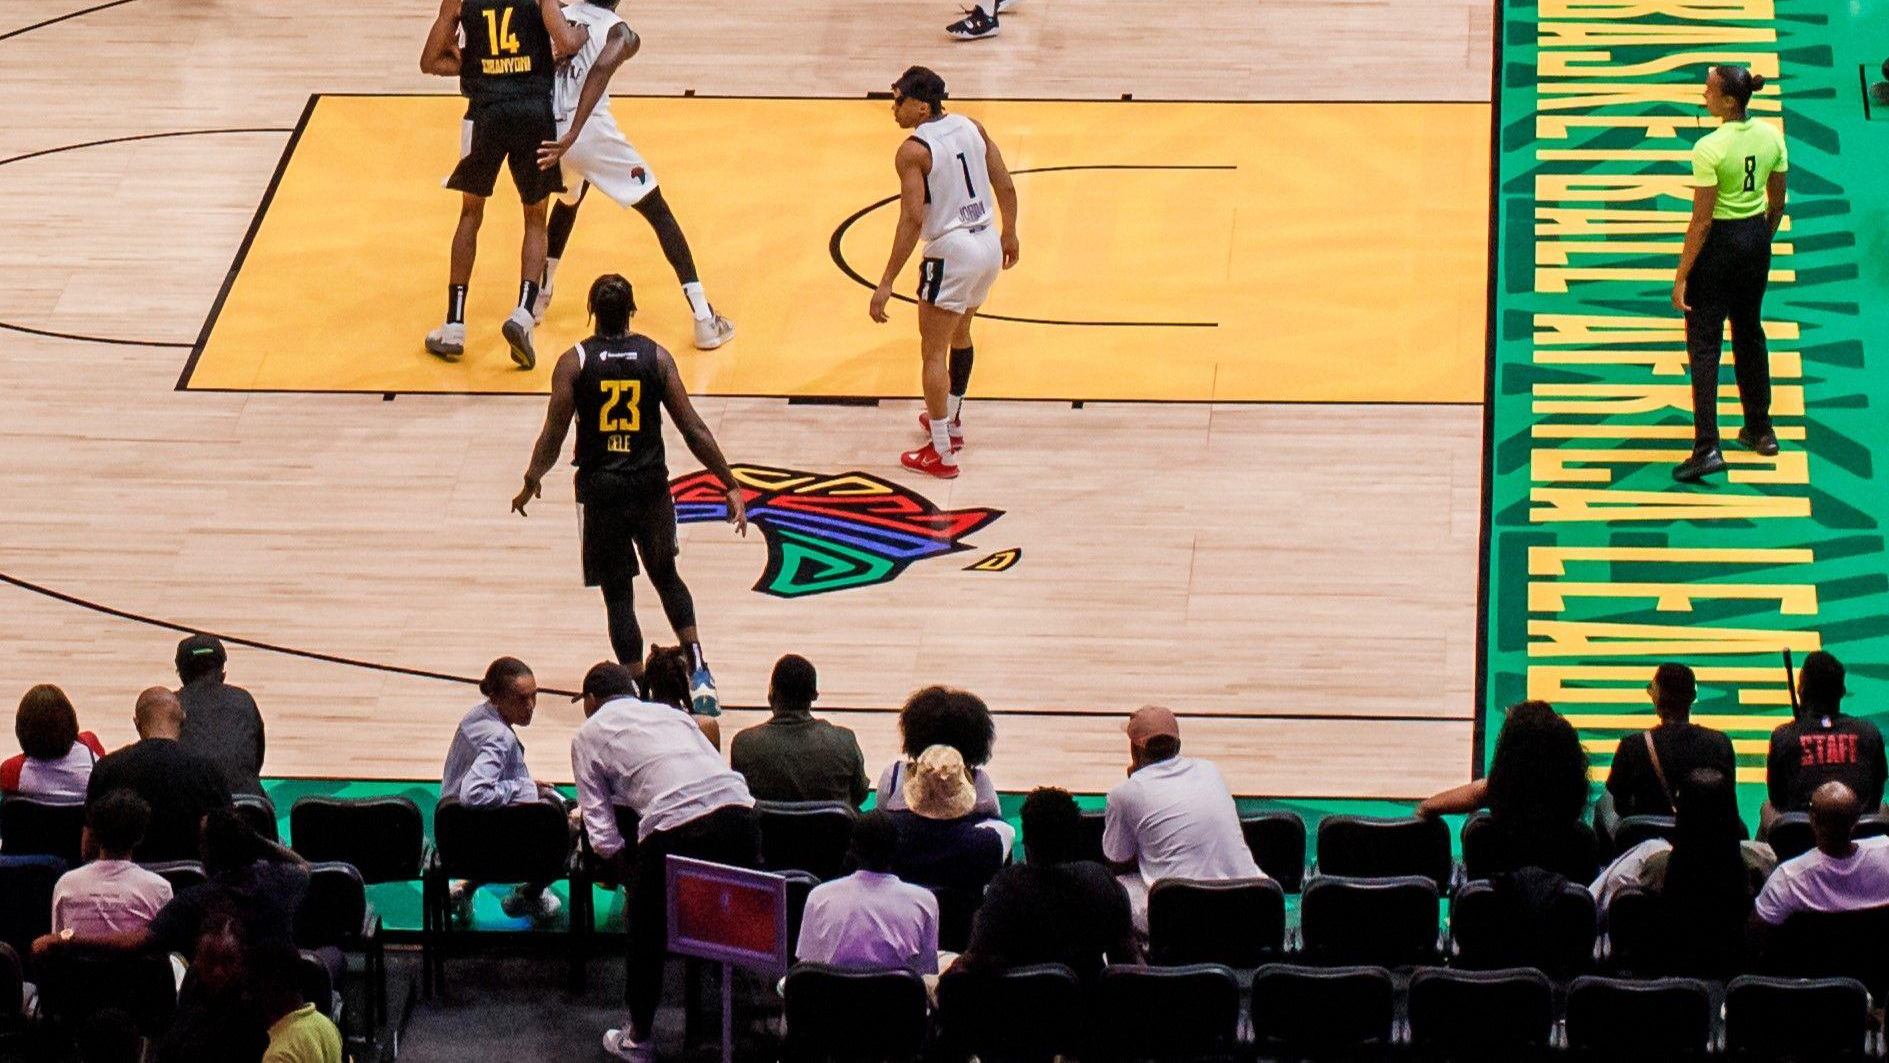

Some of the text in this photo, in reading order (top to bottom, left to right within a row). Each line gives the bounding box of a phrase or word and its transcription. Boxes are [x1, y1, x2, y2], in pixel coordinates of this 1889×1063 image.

[481, 7, 521, 56] 14
[956, 152, 976, 199] 1
[1743, 155, 1757, 192] 8
[599, 379, 641, 432] 23
[1526, 546, 1824, 784] LEAG
[1799, 734, 1858, 766] STAFF
